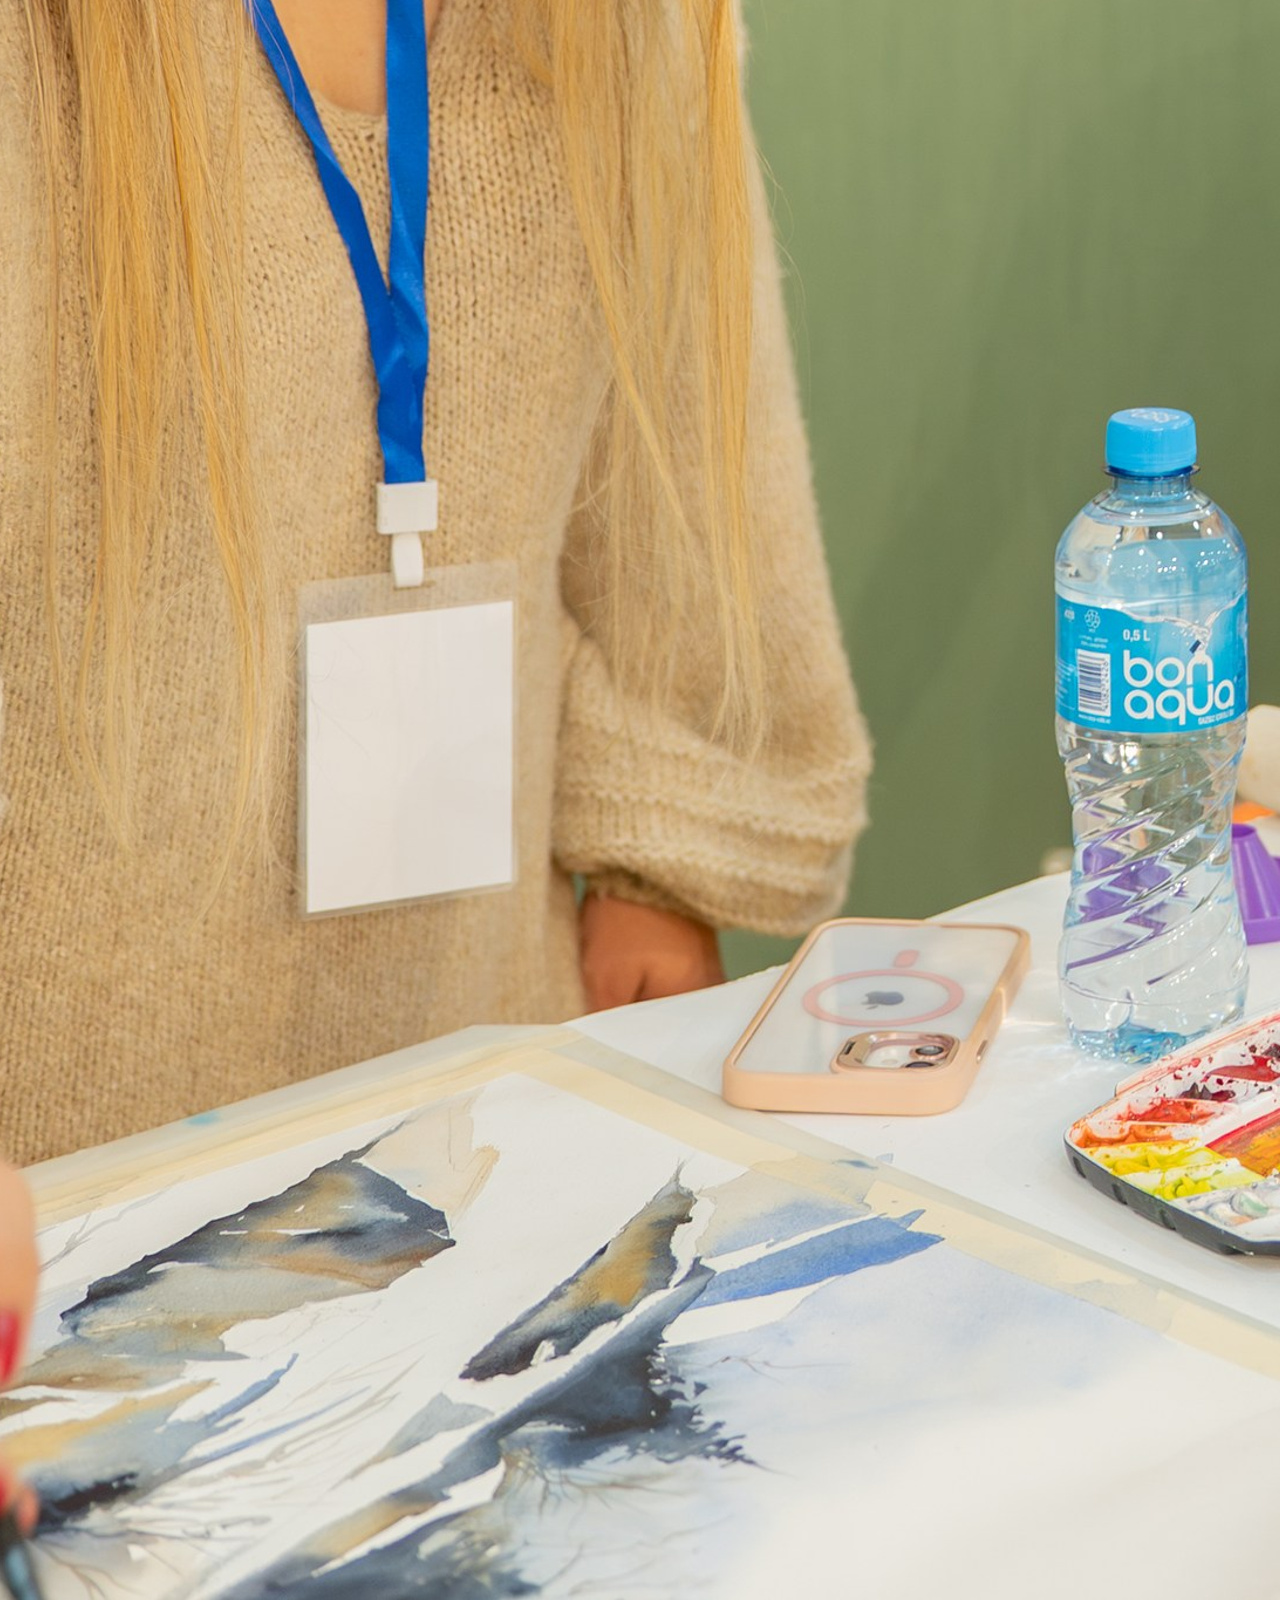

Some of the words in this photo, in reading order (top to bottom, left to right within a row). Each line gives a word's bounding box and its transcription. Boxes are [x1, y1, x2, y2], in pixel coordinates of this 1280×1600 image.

[1122, 629, 1140, 642] 0,5
[1143, 629, 1151, 641] L
[1123, 649, 1214, 688] bon
[1123, 679, 1235, 726] aqua
